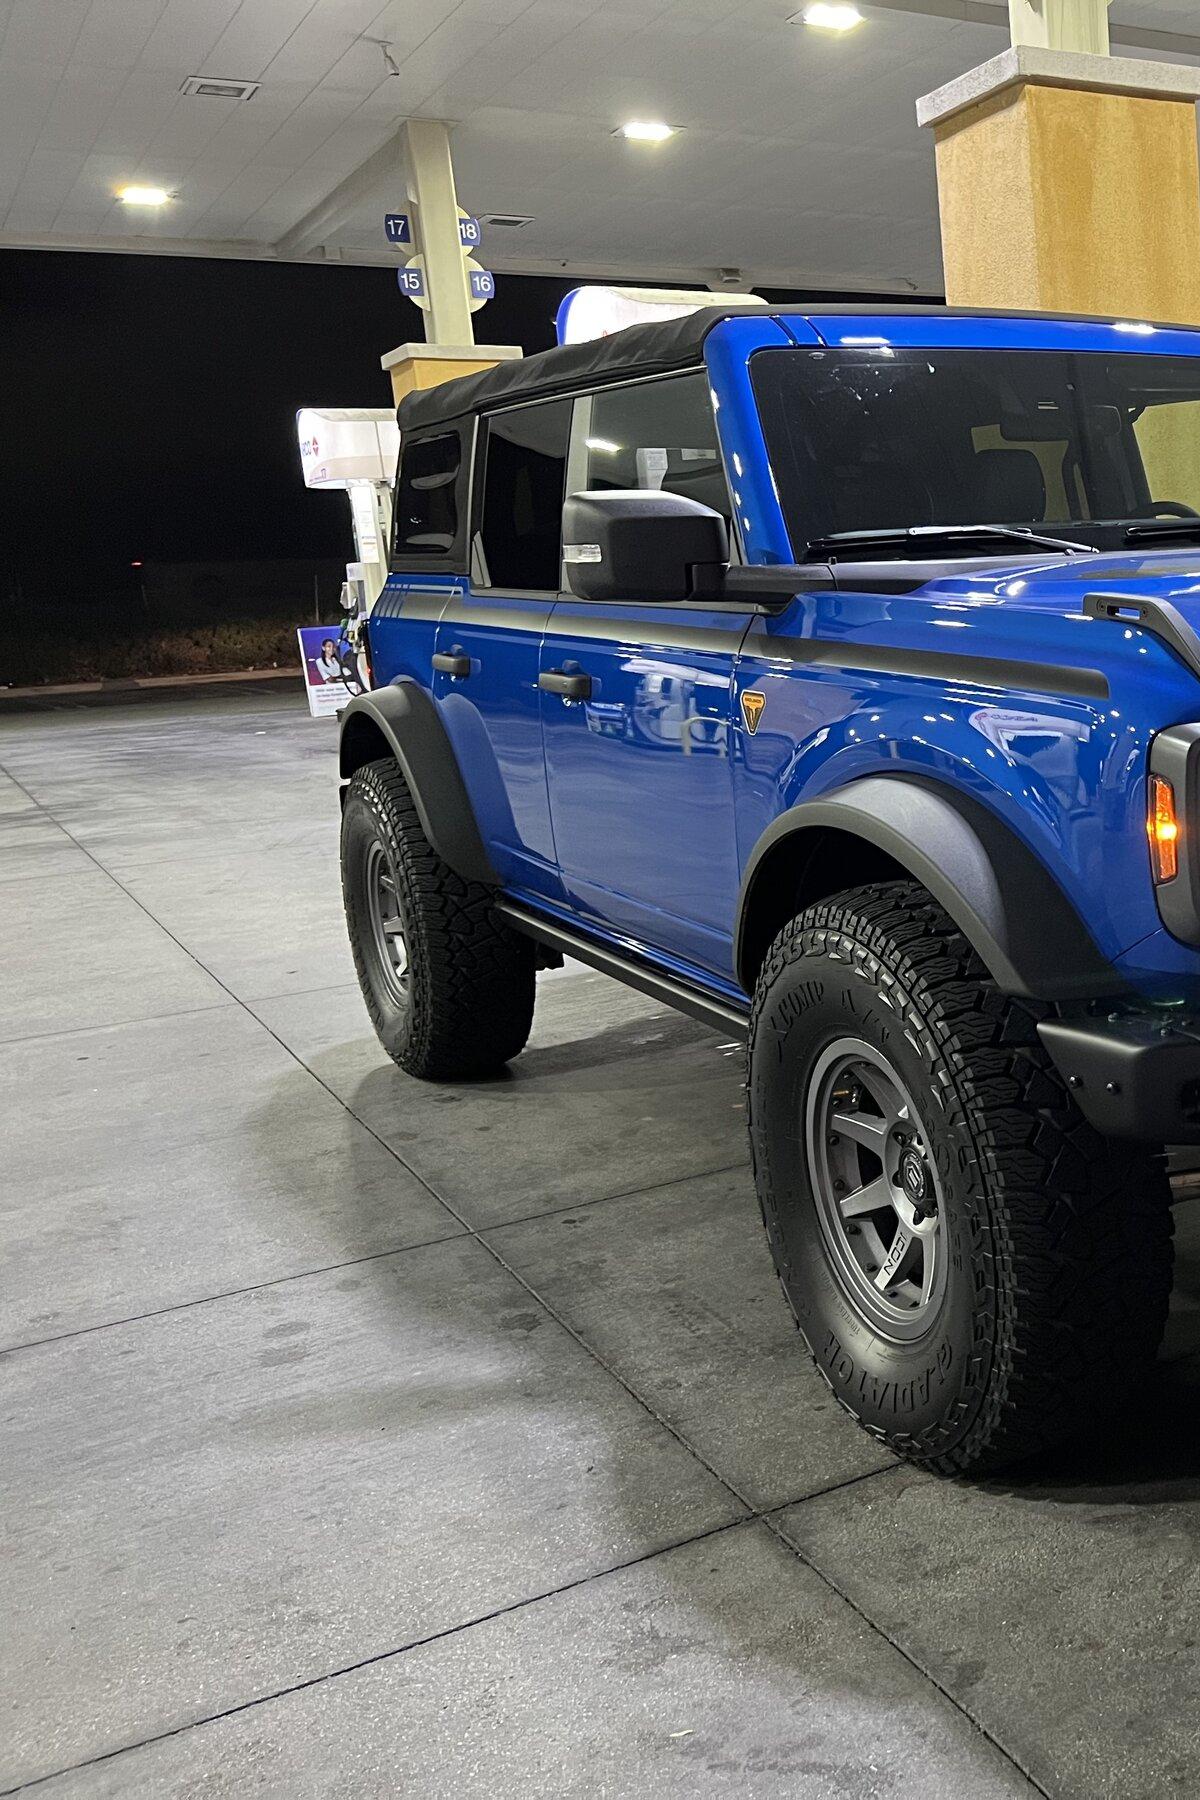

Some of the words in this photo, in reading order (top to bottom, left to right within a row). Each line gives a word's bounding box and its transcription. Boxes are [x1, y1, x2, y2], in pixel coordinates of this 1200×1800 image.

[387, 219, 405, 236] 17
[459, 223, 478, 240] 18
[400, 273, 420, 290] 15
[472, 276, 492, 292] 16
[883, 1232, 908, 1276] ICON
[824, 1328, 953, 1414] GLADIATOR
